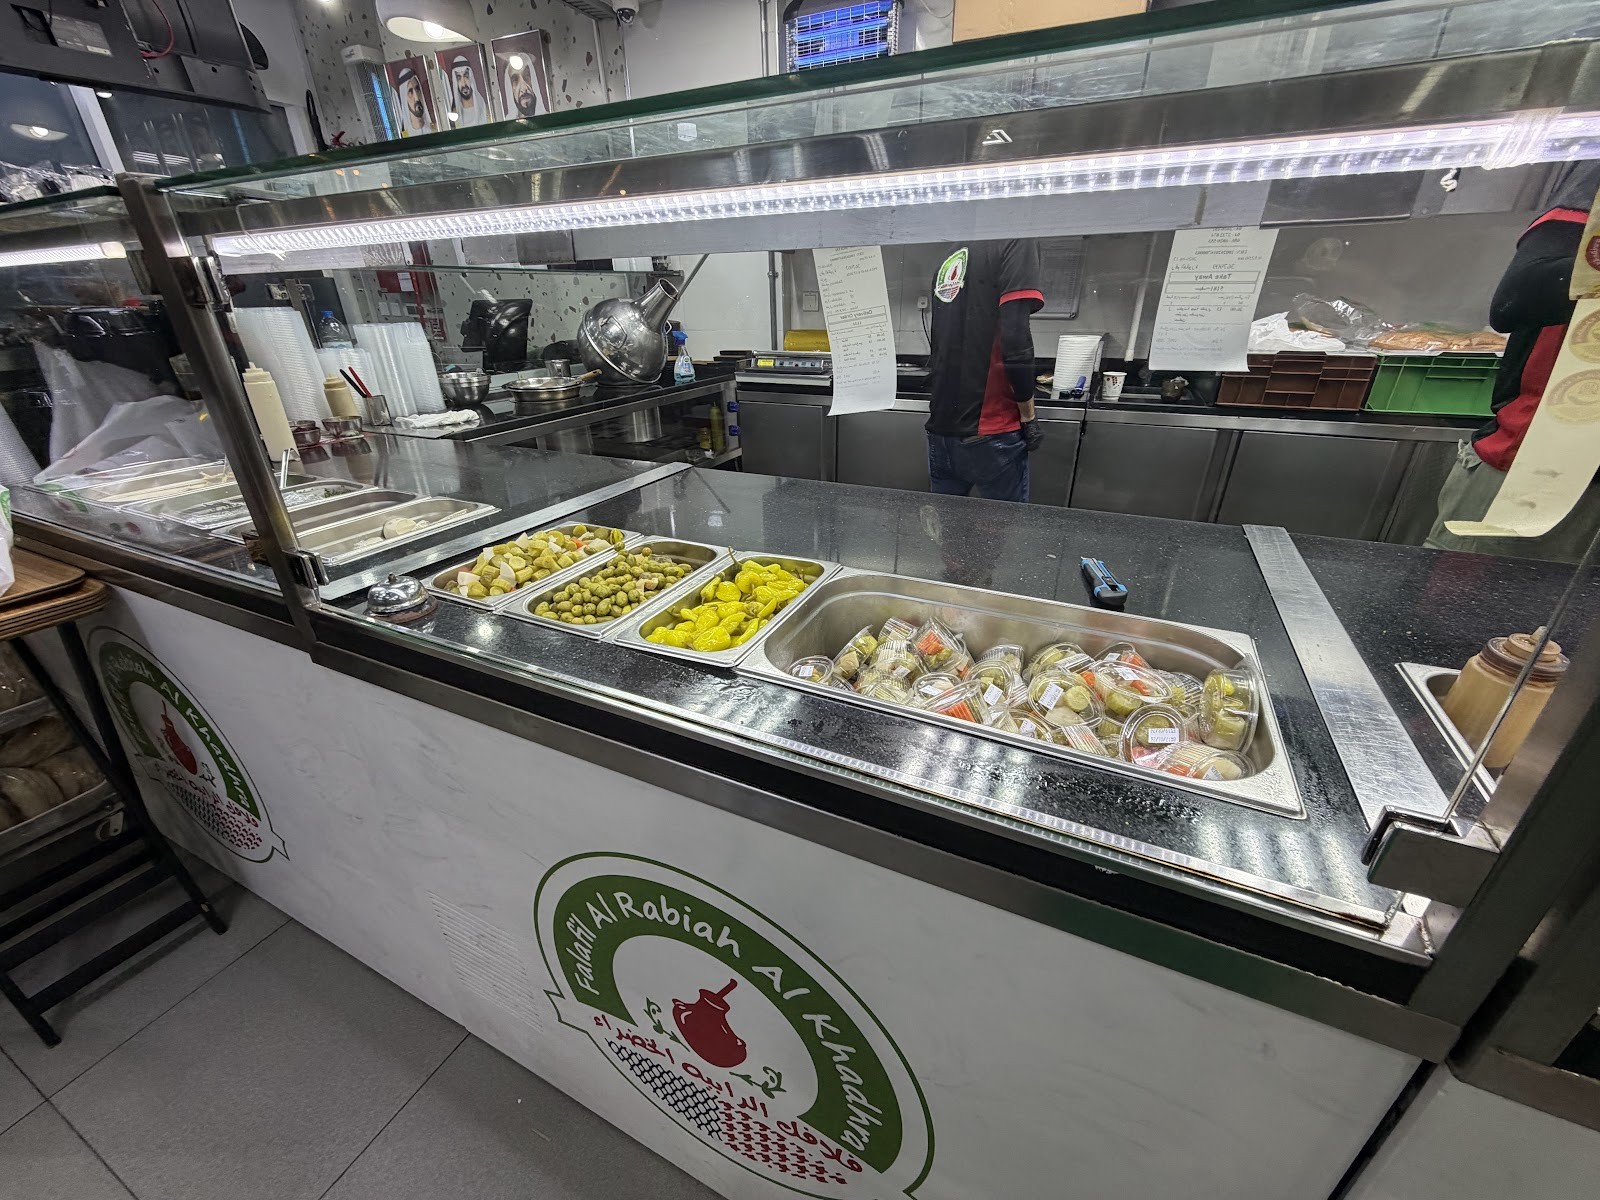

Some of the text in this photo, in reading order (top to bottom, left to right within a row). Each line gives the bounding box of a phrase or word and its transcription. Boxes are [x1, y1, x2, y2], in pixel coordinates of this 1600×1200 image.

[160, 681, 179, 705] Al
[185, 707, 250, 808] Khadhra
[585, 891, 619, 930] Al
[613, 891, 742, 959] Rabiah
[752, 965, 810, 1001] Al
[803, 1012, 884, 1153] Khadhra
[593, 1014, 675, 1064] الخضراء
[776, 1120, 863, 1173] فلافل
